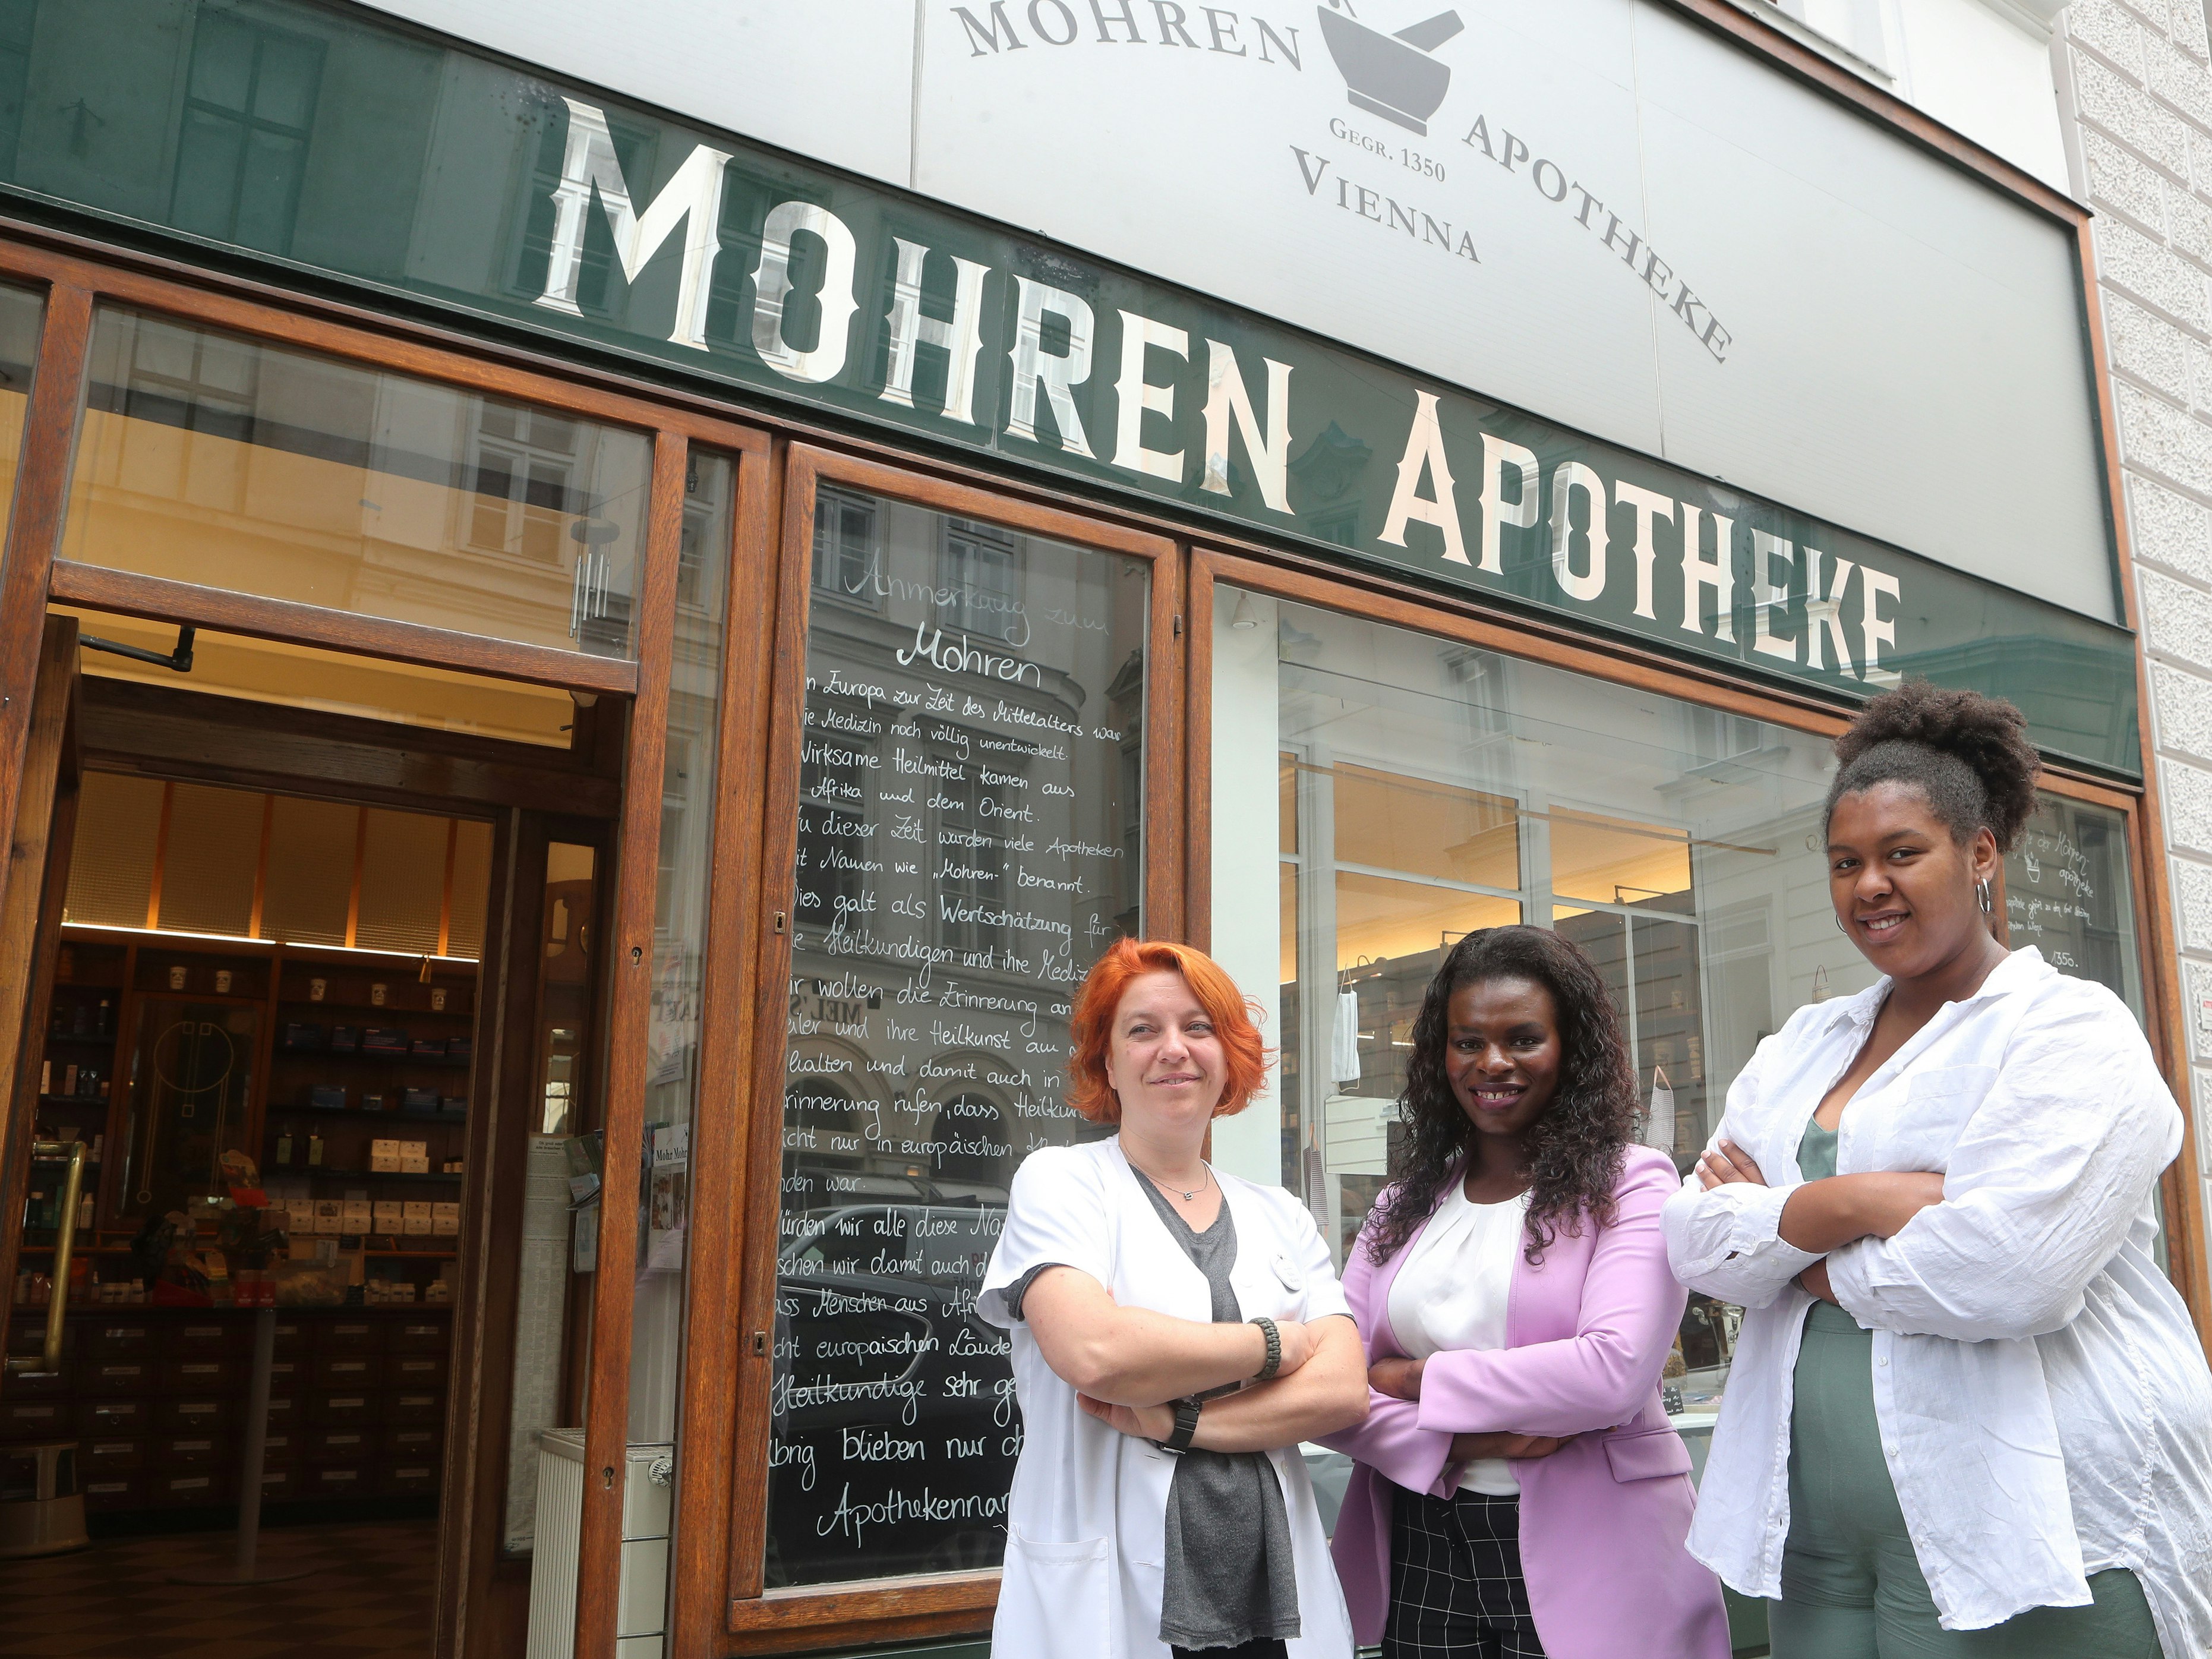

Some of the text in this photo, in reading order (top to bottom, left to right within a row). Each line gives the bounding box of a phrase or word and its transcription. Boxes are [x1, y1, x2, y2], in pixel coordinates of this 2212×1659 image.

[949, 0, 1733, 364] MOHREN APOTHEKE
[1400, 148, 1446, 182] 1350
[531, 95, 1902, 691] MOHREN APOTHEKE
[895, 621, 1042, 687] Mohren
[806, 670, 1122, 742] n Europa zur Zeit des Mittelalters war
[803, 707, 815, 726] ie
[821, 707, 882, 734] Medizin
[890, 720, 922, 740] noch
[930, 724, 970, 761] völlig
[892, 747, 966, 781] Heilmittel
[1042, 783, 1075, 797] aus
[810, 775, 1040, 824] Afrika und dem Orient.
[796, 847, 807, 866] it
[819, 846, 883, 873] Namen
[895, 862, 919, 875] wie
[822, 810, 879, 838] dieser
[891, 813, 927, 845] Zeit
[938, 828, 993, 849] wurden
[1004, 834, 1034, 852] viele
[1045, 836, 1124, 862] Apotheken
[834, 889, 877, 931] galt
[891, 892, 926, 920] als
[940, 894, 1073, 956] Wertschätzung
[1084, 913, 1112, 948] für
[823, 921, 954, 989] Heilkundigen
[963, 945, 993, 970] und
[1003, 950, 1031, 973] ihre
[1037, 948, 1089, 982] Mediz
[818, 972, 884, 1000] wollen
[897, 976, 933, 1007] die
[939, 980, 1038, 1039] Erinnerung
[835, 1016, 869, 1039] und
[886, 1018, 920, 1043] ihre
[929, 1019, 1011, 1051] Heilkunst
[866, 1055, 906, 1077] und
[919, 1063, 977, 1080] damit
[986, 1067, 1032, 1087] auch
[1043, 1069, 1060, 1088] in
[784, 1090, 881, 1141] rinnerung
[655, 1149, 673, 1162] Mohr
[831, 1135, 860, 1151] nur
[876, 1134, 892, 1153] in
[901, 1132, 1013, 1169] europäischen
[780, 1208, 826, 1238] ürden
[834, 1217, 864, 1237] wir
[873, 1206, 907, 1238] alle
[915, 1208, 958, 1238] diese
[833, 1257, 860, 1276] wir
[870, 1248, 923, 1275] damit
[931, 1254, 970, 1275] auch
[812, 1287, 889, 1318] Menschen
[894, 1296, 928, 1313] aus
[771, 1372, 927, 1427] Heilkundige
[842, 1427, 926, 1462] blieben
[946, 1436, 987, 1459] nur
